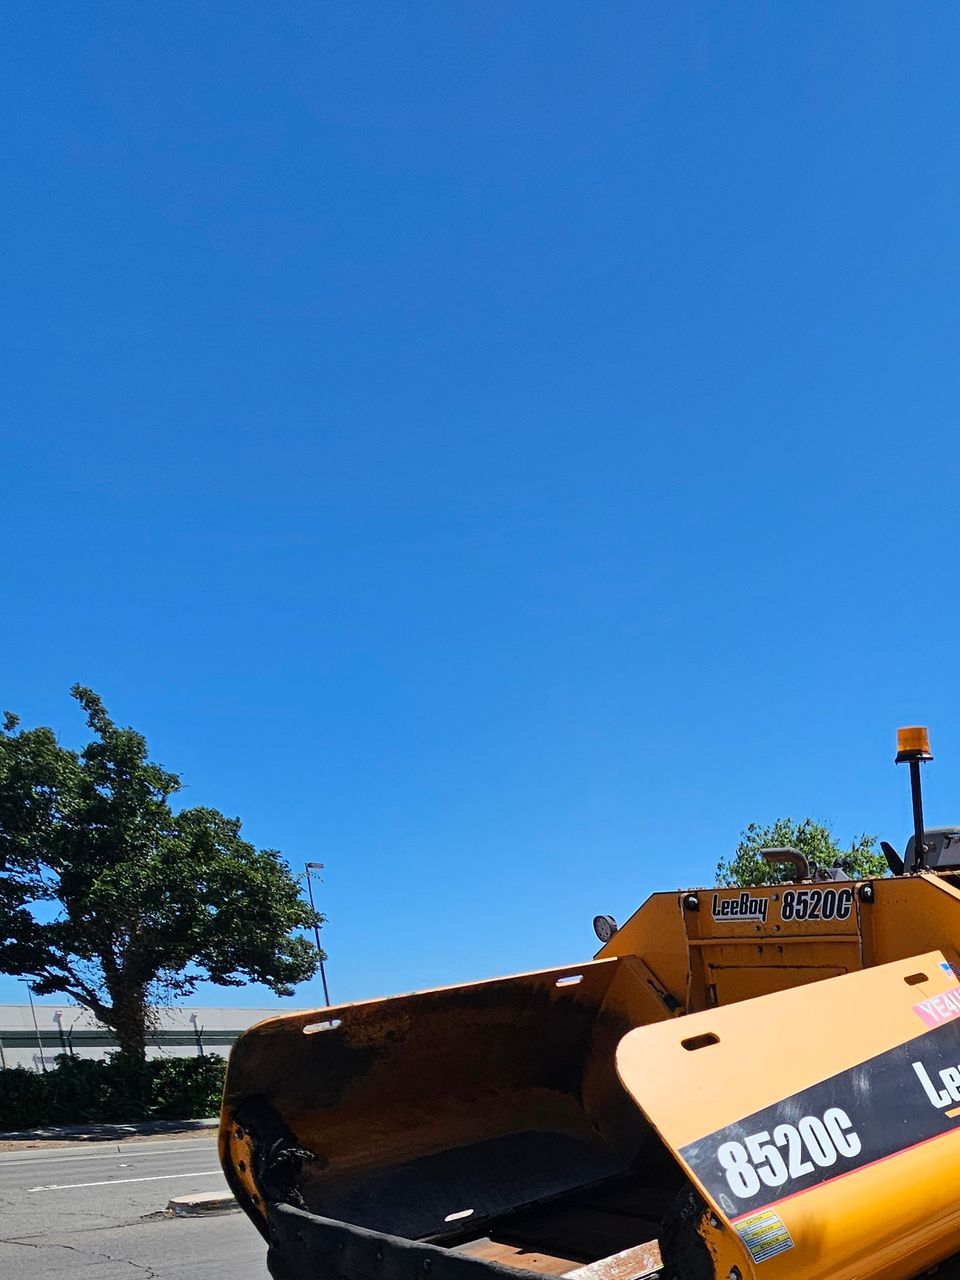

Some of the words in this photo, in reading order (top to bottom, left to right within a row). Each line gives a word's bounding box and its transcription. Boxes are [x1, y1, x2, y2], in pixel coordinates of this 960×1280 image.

[712, 893, 769, 923] LeeBoy
[781, 889, 852, 922] 8520C
[717, 1107, 862, 1199] 8520C
